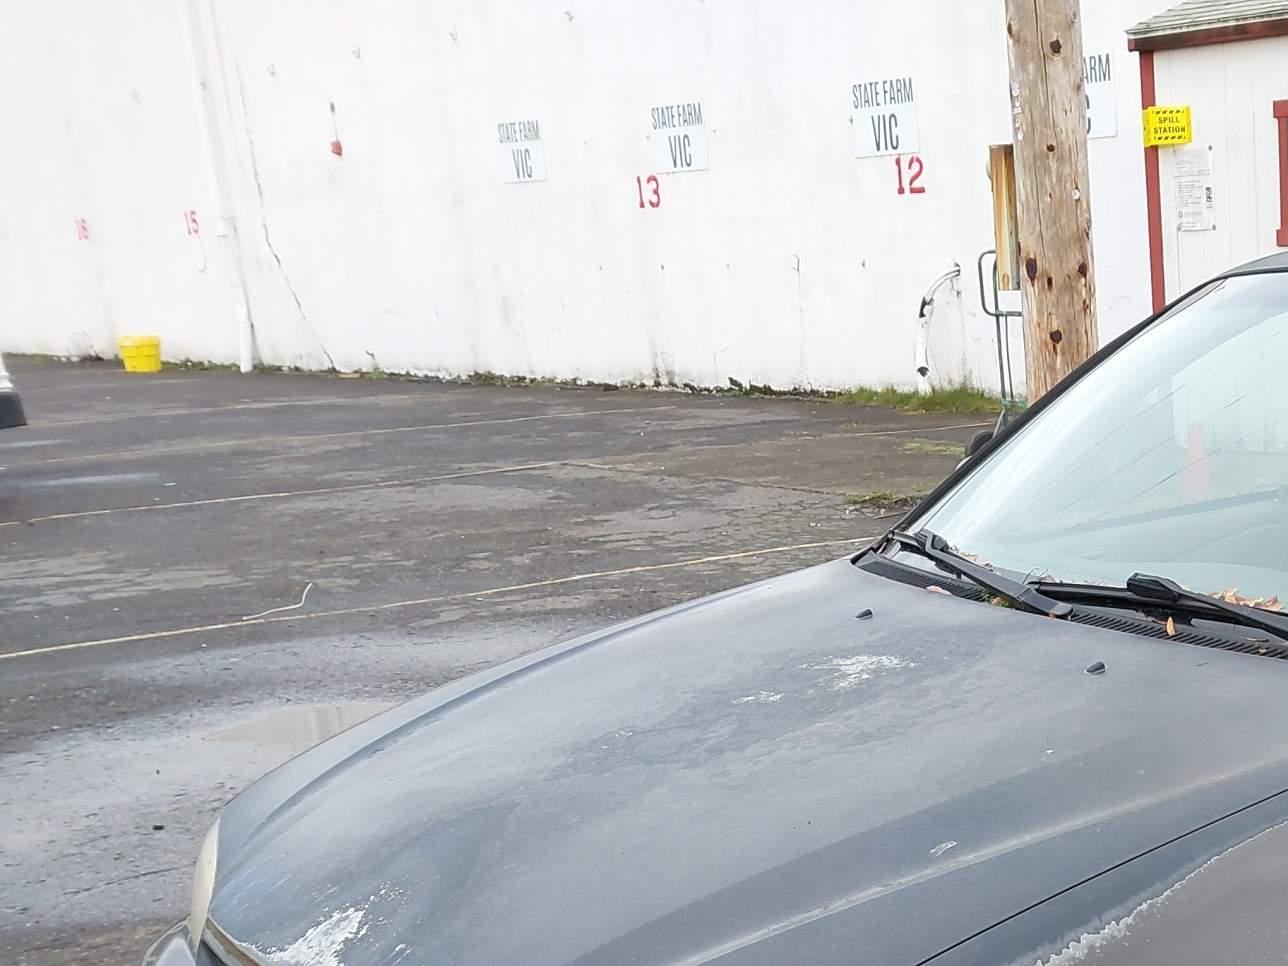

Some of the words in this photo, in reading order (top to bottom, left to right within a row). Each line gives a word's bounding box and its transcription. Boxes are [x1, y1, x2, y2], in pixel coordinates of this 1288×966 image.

[1083, 53, 1111, 84] ARM
[852, 82, 880, 109] STATE
[882, 77, 914, 106] FARM
[651, 107, 676, 130] STATE
[677, 102, 704, 127] FARM
[1153, 126, 1186, 135] STATION
[1158, 116, 1180, 124] SPILL
[498, 123, 519, 144] STATE
[518, 120, 541, 142] FARM
[871, 113, 899, 152] VIC
[512, 148, 532, 179] VIC
[668, 134, 693, 168] VIC
[895, 156, 926, 195] 12
[636, 175, 661, 209] 13
[184, 209, 199, 236] 15
